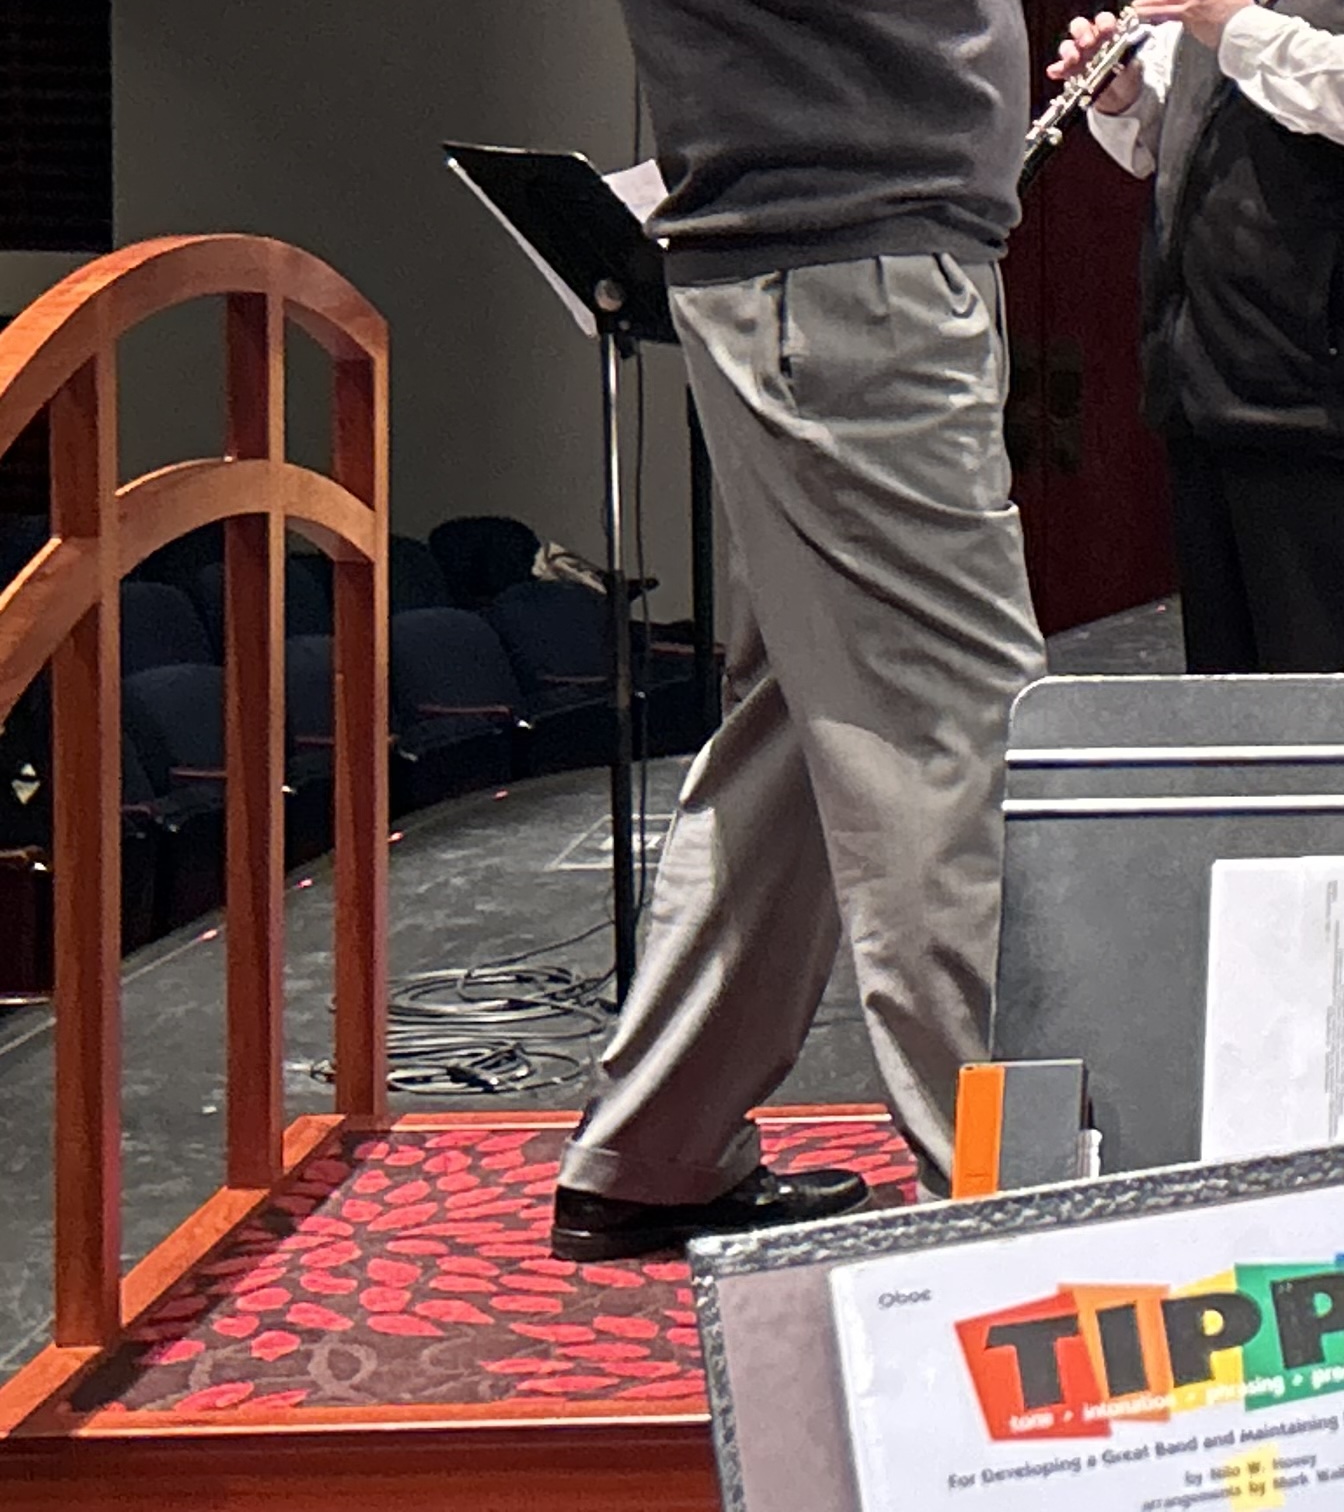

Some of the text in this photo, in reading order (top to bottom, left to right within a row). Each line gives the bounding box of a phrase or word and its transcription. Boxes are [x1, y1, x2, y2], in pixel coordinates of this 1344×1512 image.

[877, 1288, 931, 1309] Oboe
[1010, 1410, 1054, 1431] tone
[948, 1473, 976, 1489] For
[981, 1456, 1082, 1483] Developing
[1087, 1455, 1097, 1468] a
[1102, 1445, 1149, 1465] Great
[1155, 1437, 1198, 1457] Band
[1203, 1431, 1235, 1449] and
[1240, 1415, 1339, 1443] Maintaining
